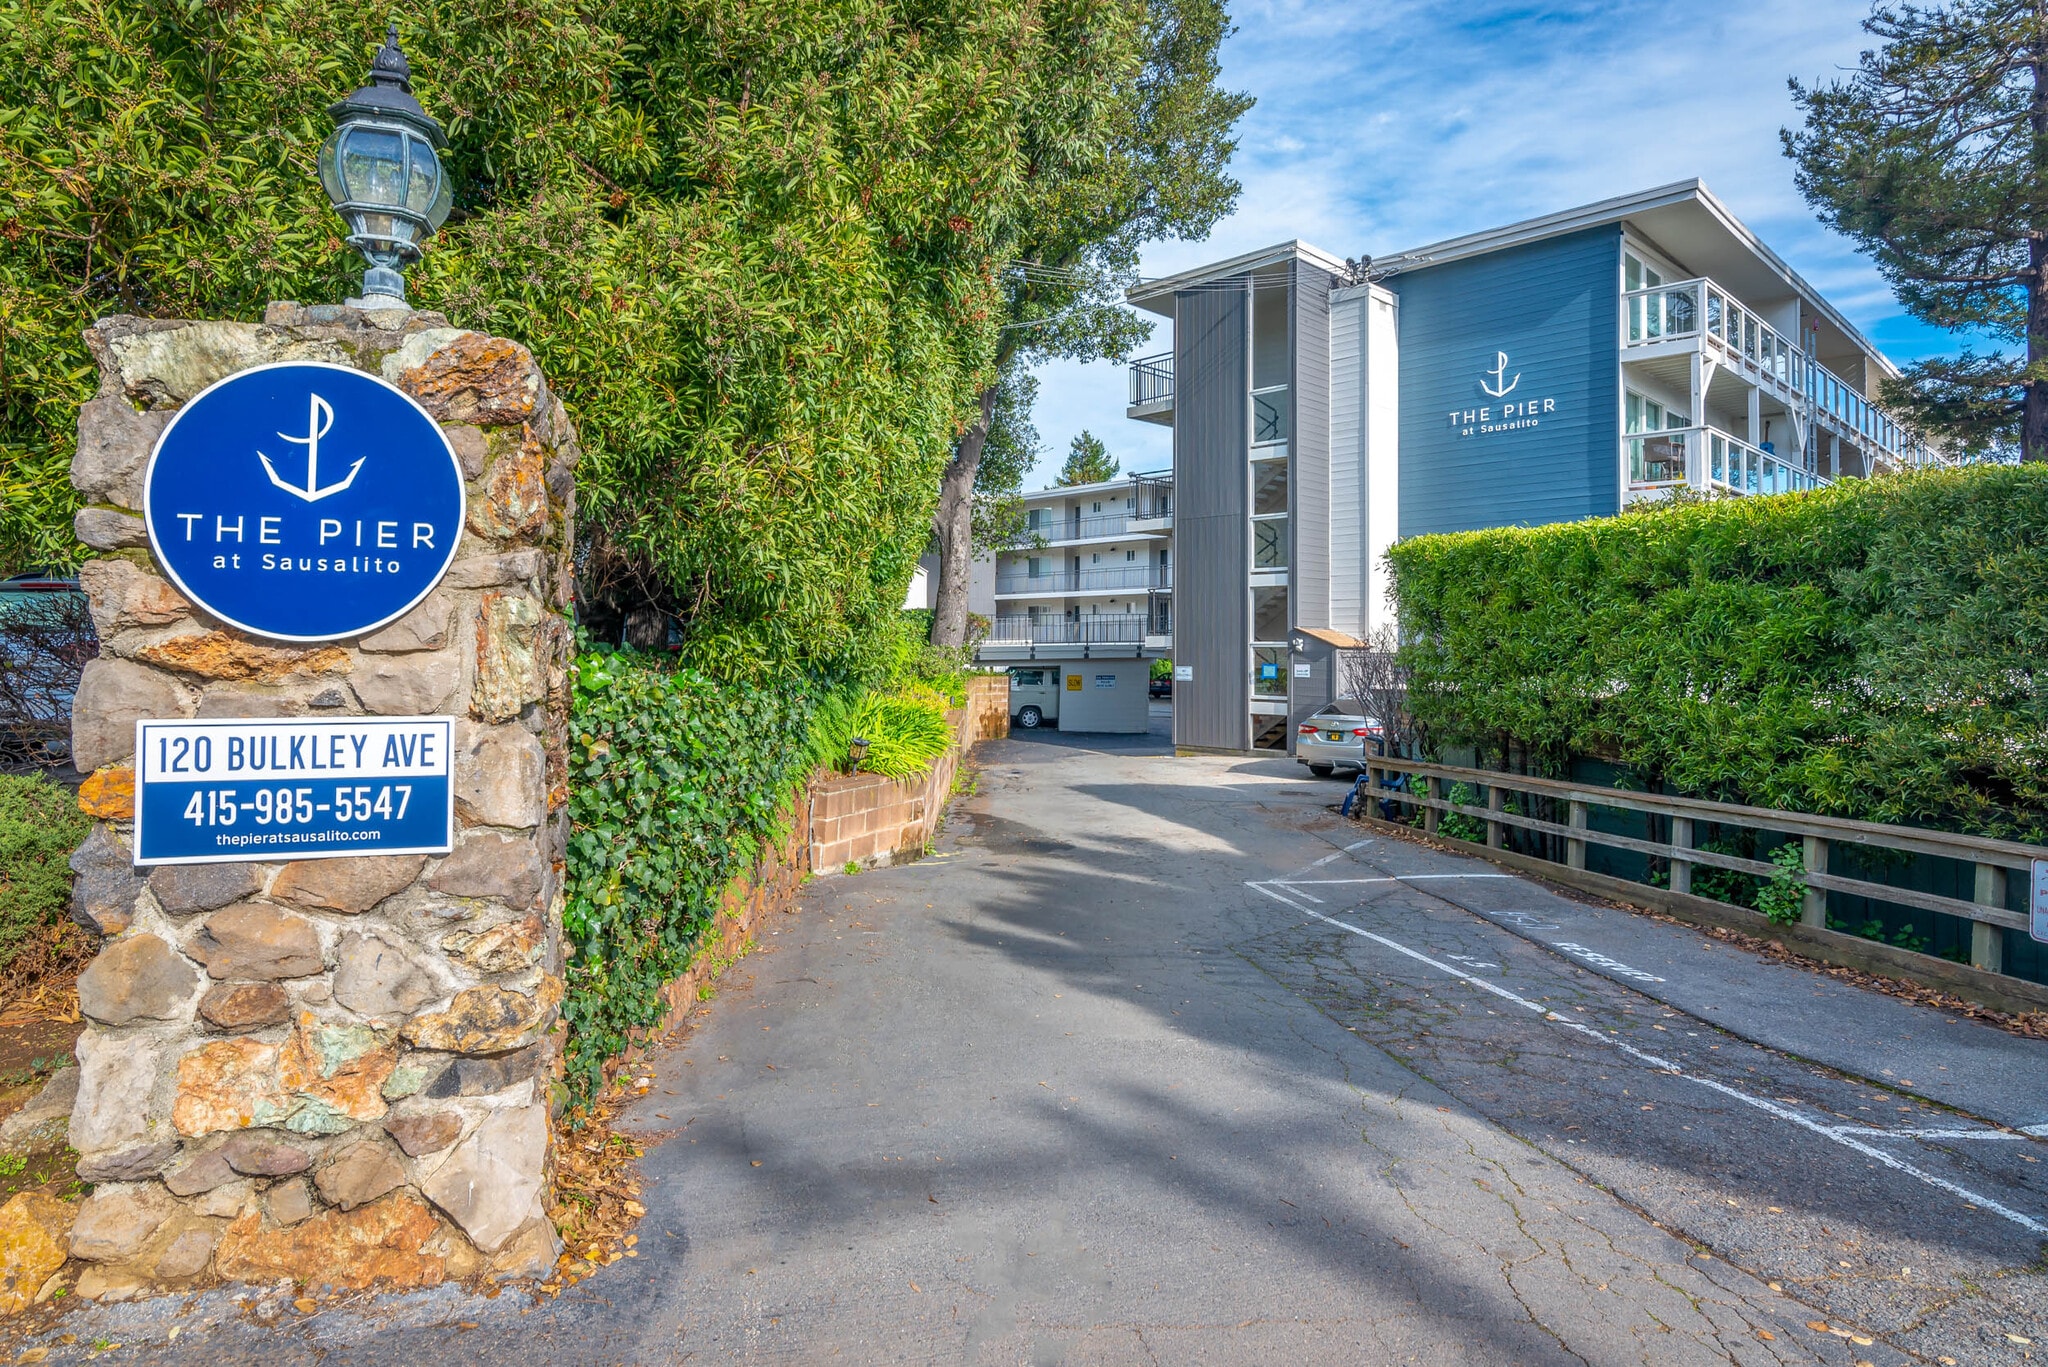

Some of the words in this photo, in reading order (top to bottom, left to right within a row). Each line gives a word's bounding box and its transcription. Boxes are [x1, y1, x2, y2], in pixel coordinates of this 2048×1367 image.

[1449, 407, 1490, 426] THE
[1504, 398, 1555, 418] PIER
[1462, 426, 1474, 436] at
[1480, 418, 1539, 433] Sausalito
[176, 513, 282, 545] THE
[319, 518, 435, 550] PIER
[213, 554, 241, 570] at
[262, 553, 401, 574] Sausalito
[159, 735, 212, 773] 120
[227, 734, 368, 772] BULKLEY
[382, 733, 436, 768] AVE
[183, 785, 412, 827] 415-985-5547
[216, 829, 381, 848] thepieratsausalito.com
[1551, 942, 1667, 983] RESERVED
